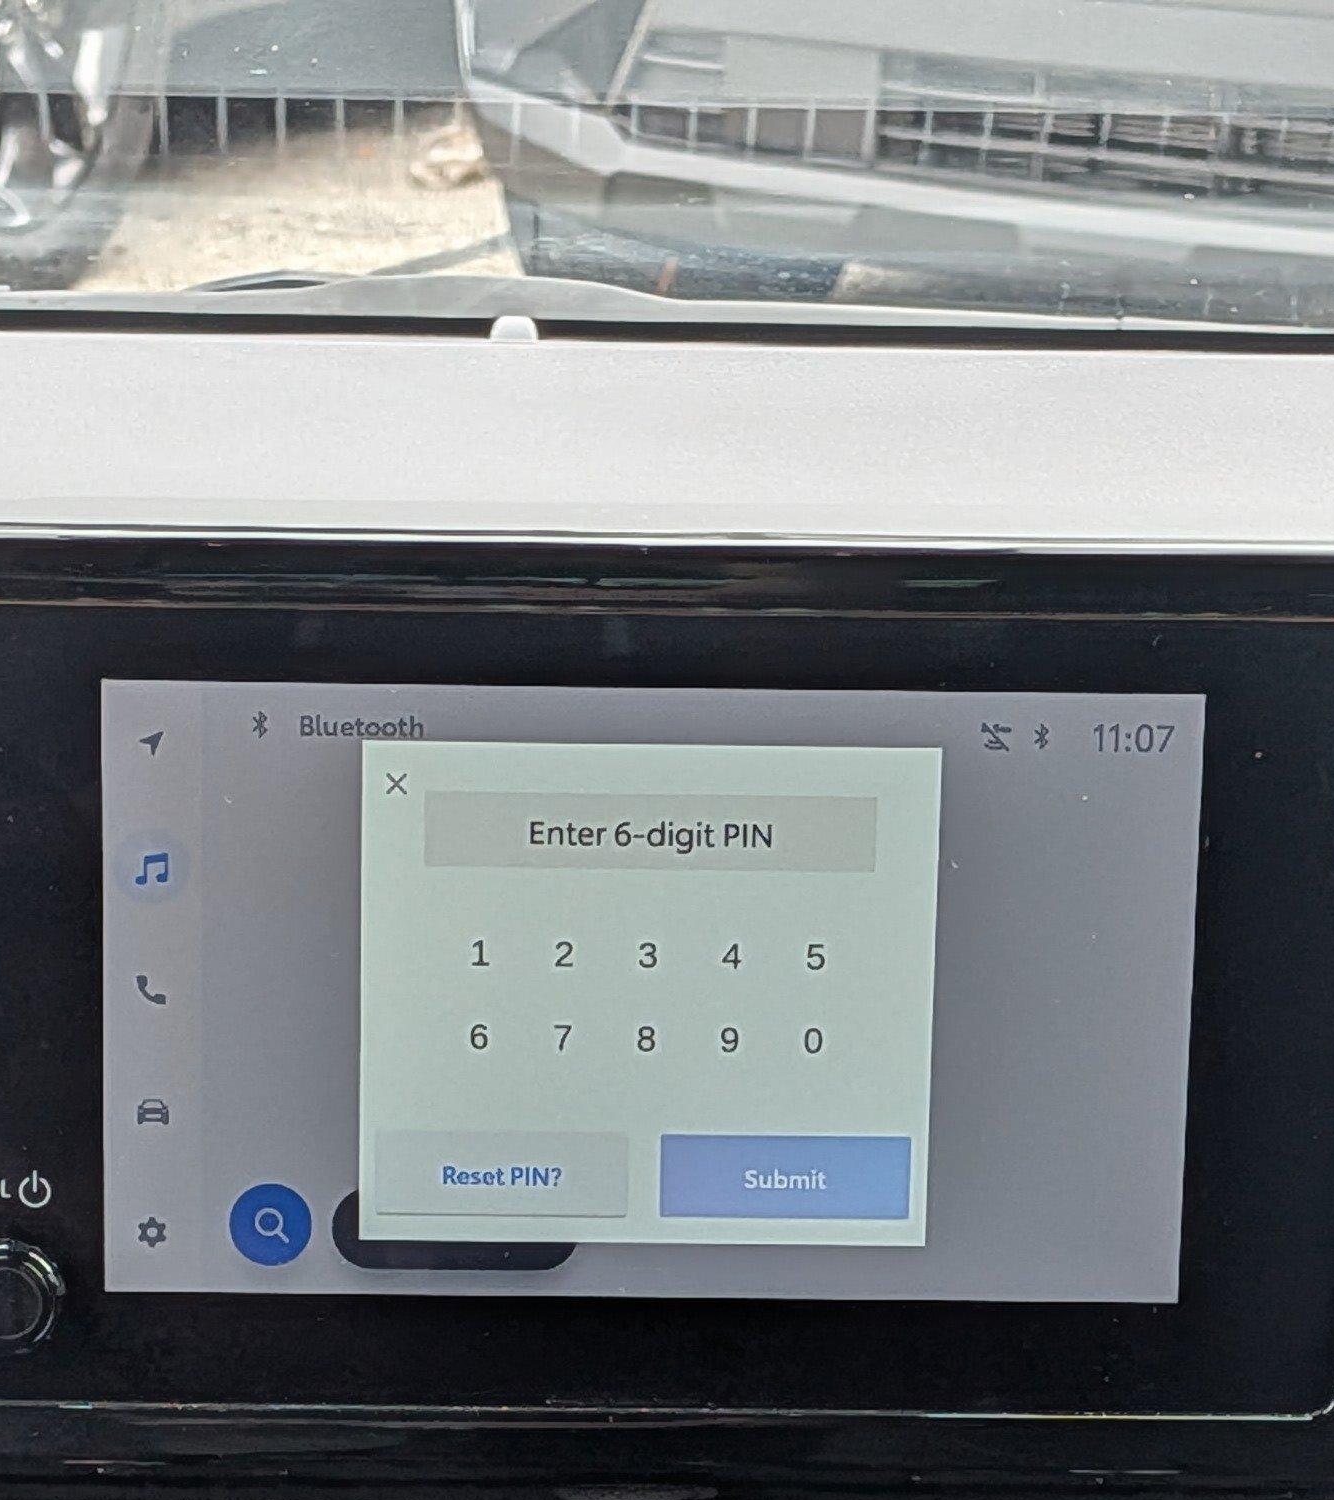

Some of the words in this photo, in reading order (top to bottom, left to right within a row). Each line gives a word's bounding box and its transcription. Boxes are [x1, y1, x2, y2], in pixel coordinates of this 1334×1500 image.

[299, 714, 425, 738] Bluetooth
[1093, 723, 1176, 752] 11:07
[529, 821, 607, 847] Enter
[613, 821, 715, 855] 6-digit
[723, 823, 773, 848] PIN
[470, 939, 490, 967] 1
[553, 941, 574, 967] 2
[638, 942, 658, 968] 3
[721, 943, 742, 970] 4
[806, 943, 826, 970] 5
[469, 1023, 489, 1050] 6
[553, 1024, 573, 1051] 7
[636, 1025, 656, 1052] 8
[720, 1026, 740, 1053] 9
[803, 1027, 824, 1054] 0
[441, 1165, 505, 1187] Reset
[510, 1166, 563, 1188] PIN?
[744, 1169, 827, 1190] Submit
